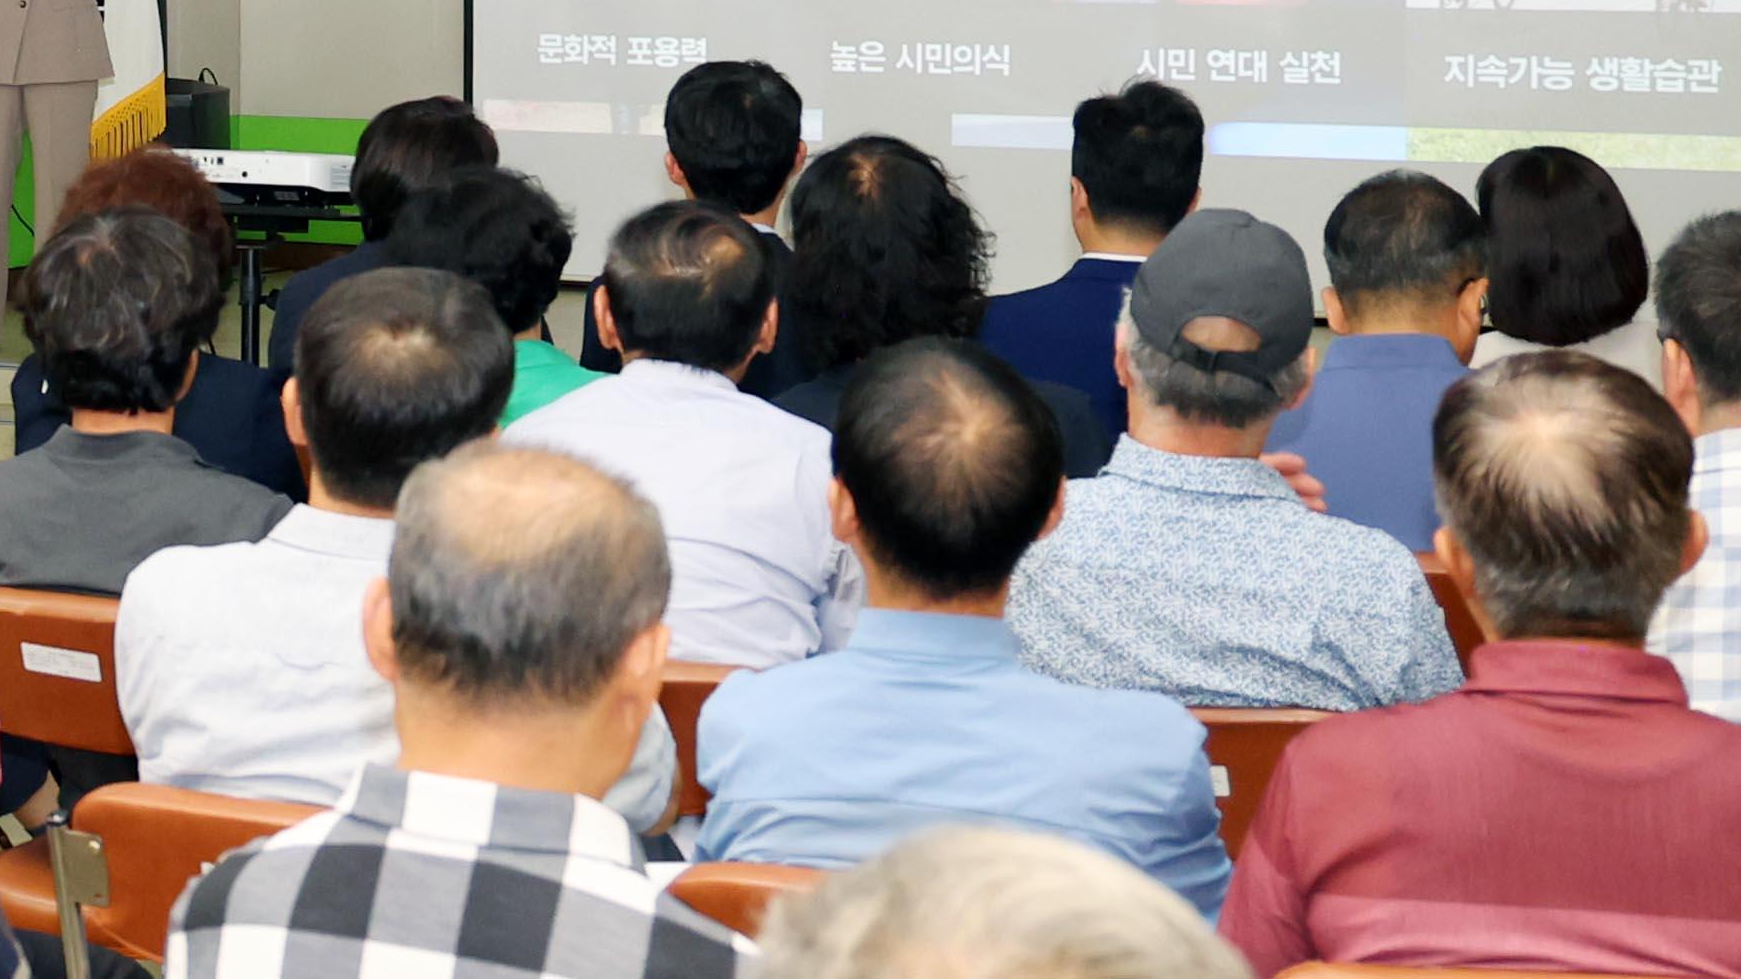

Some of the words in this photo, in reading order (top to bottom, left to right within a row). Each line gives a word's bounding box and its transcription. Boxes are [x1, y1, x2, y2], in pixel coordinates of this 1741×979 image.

[537, 34, 617, 65] 문화적
[627, 36, 708, 68] 포용력
[830, 40, 887, 73] 높은
[895, 42, 1011, 76] 시민의식
[1136, 48, 1196, 81] 시민
[1206, 49, 1267, 84] 연대
[1279, 50, 1342, 85] 실천
[1444, 54, 1575, 91] 지속가능
[1585, 55, 1723, 94] 생활습관
